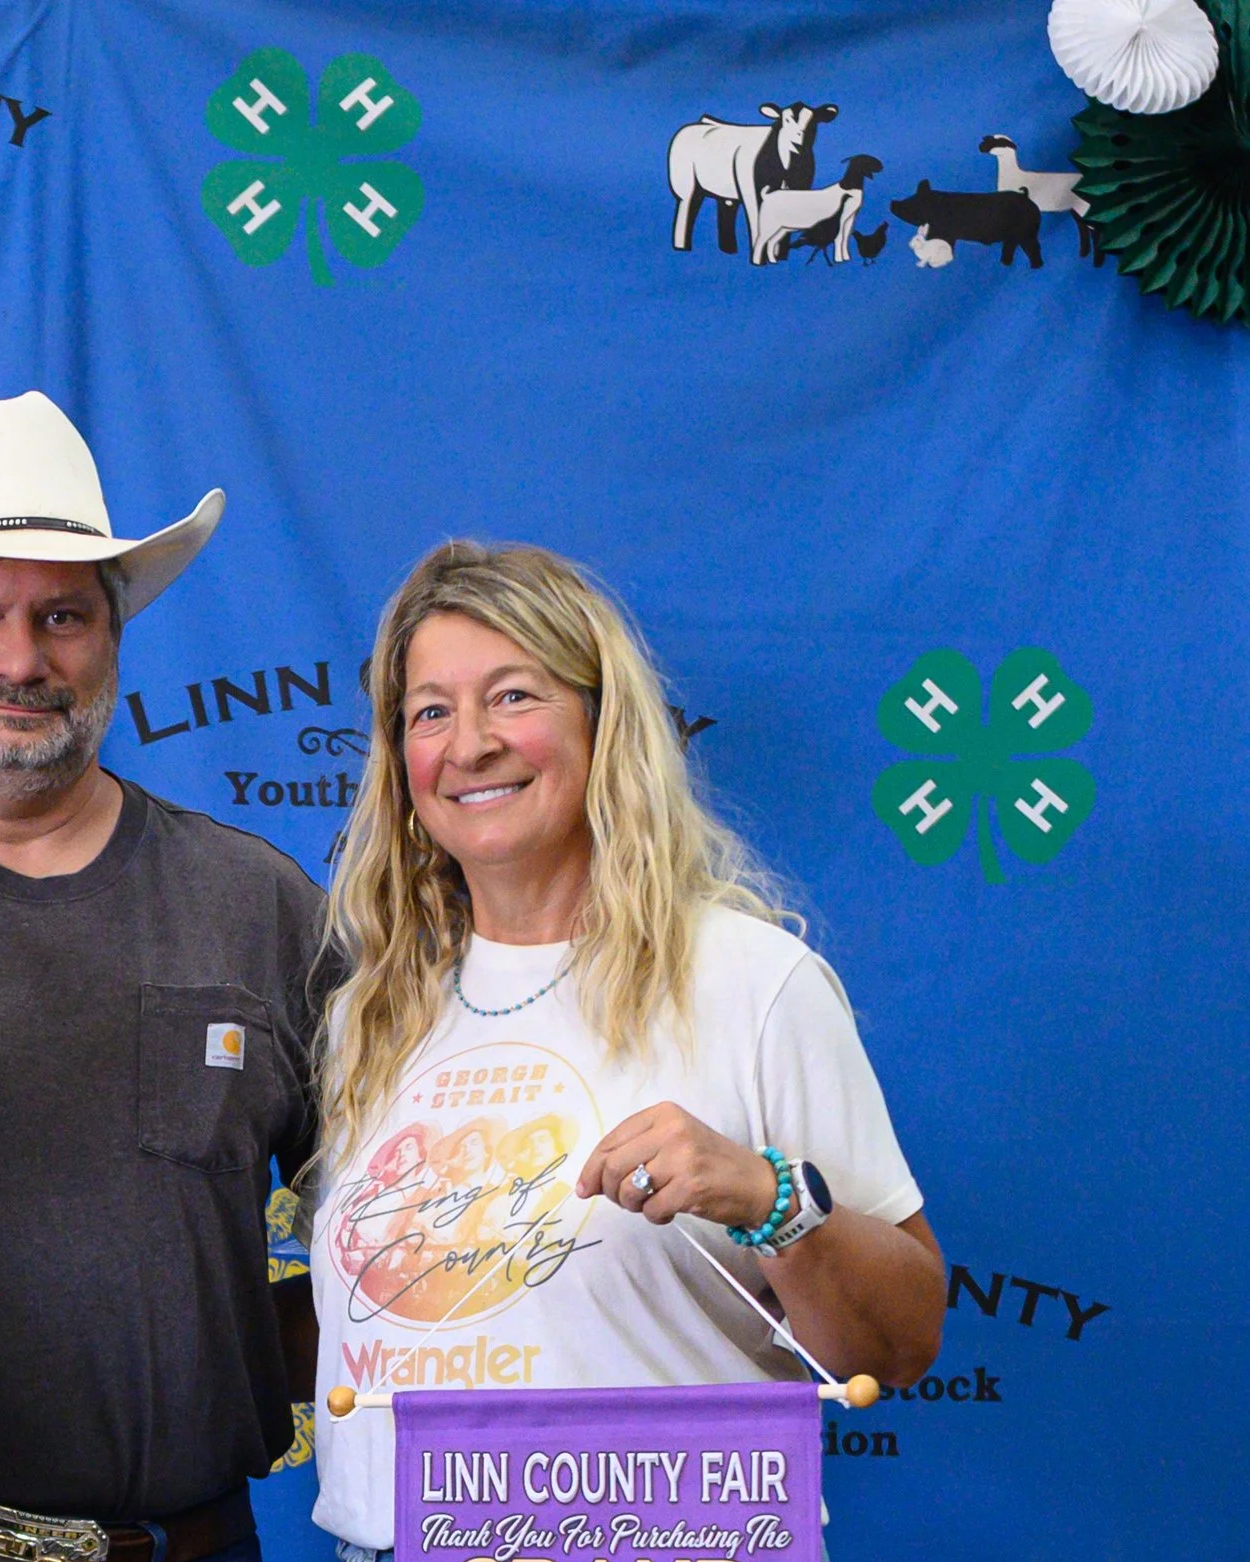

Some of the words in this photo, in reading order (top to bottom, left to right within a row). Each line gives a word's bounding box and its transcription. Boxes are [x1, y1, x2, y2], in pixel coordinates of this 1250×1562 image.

[232, 78, 287, 134] H
[338, 77, 394, 131] H
[226, 179, 282, 235] H
[342, 181, 398, 238] H
[125, 661, 331, 745] LINN
[904, 677, 959, 734] H
[1011, 672, 1066, 729] H
[898, 778, 953, 835] H
[1014, 777, 1069, 833] H
[430, 1085, 542, 1109] STRAIT
[435, 1064, 548, 1088] GEORGE
[508, 1152, 568, 1216] of
[947, 1263, 1113, 1342] NTY
[341, 1335, 541, 1391] Wrangler
[421, 1452, 508, 1503] LINN
[523, 1451, 687, 1503] COUNTY
[701, 1451, 788, 1503] FAIR
[421, 1513, 493, 1552] Thank
[494, 1513, 556, 1562] You
[558, 1513, 604, 1554] For
[608, 1513, 743, 1560] Purchasing
[746, 1513, 794, 1553] The
